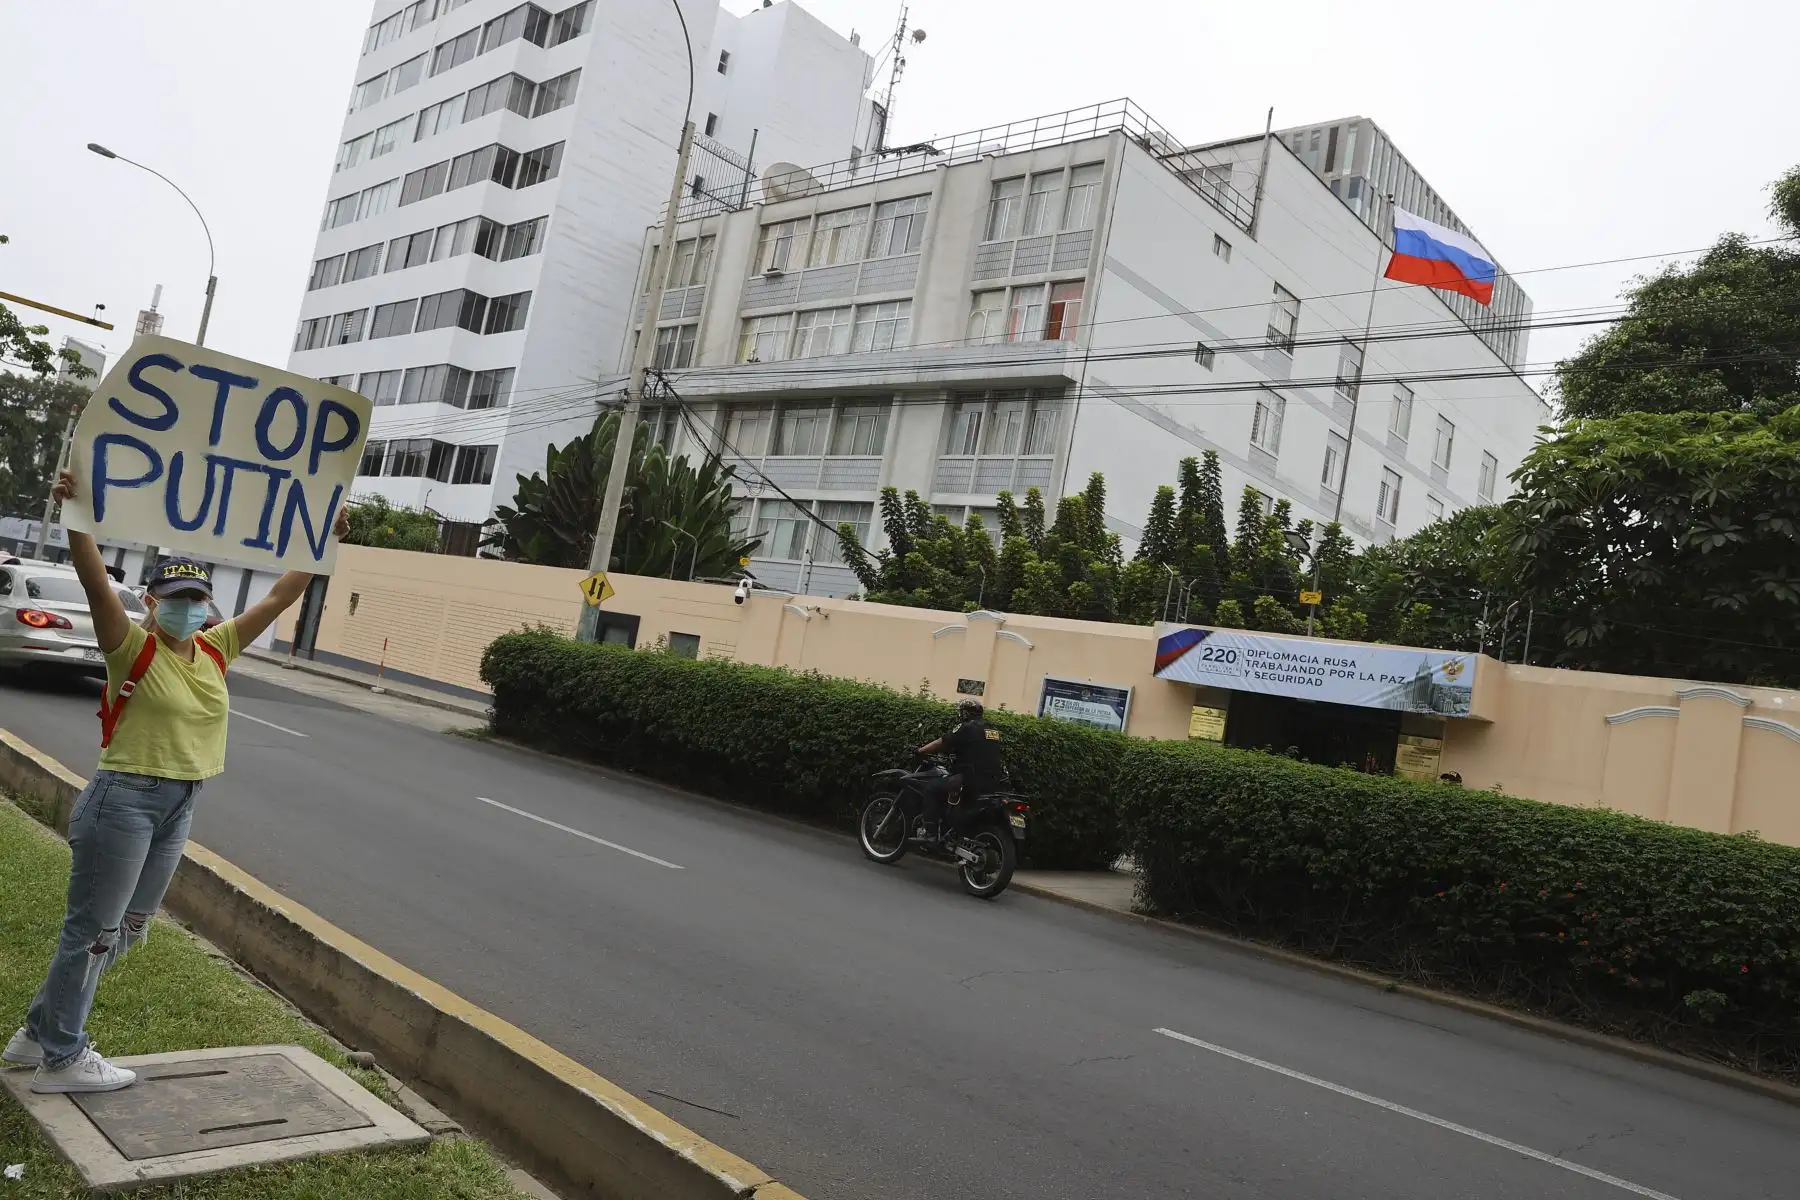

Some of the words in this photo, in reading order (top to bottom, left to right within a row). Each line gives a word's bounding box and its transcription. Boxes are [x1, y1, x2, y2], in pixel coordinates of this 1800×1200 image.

[108, 353, 361, 475] STOP
[92, 433, 343, 561] PUTIN
[163, 563, 207, 579] ITALIA
[1202, 647, 1237, 664] 220
[1247, 649, 1319, 665] DIPLOMACIA
[1323, 657, 1357, 668] RUSA
[1244, 669, 1251, 678] Y
[1254, 671, 1323, 687] SEGURIDAD
[1245, 659, 1325, 676] TRABAJANDO
[1329, 669, 1355, 679] POR
[1359, 672, 1375, 682] LA
[1380, 674, 1406, 685] PAZ
[1054, 699, 1065, 709] 23
